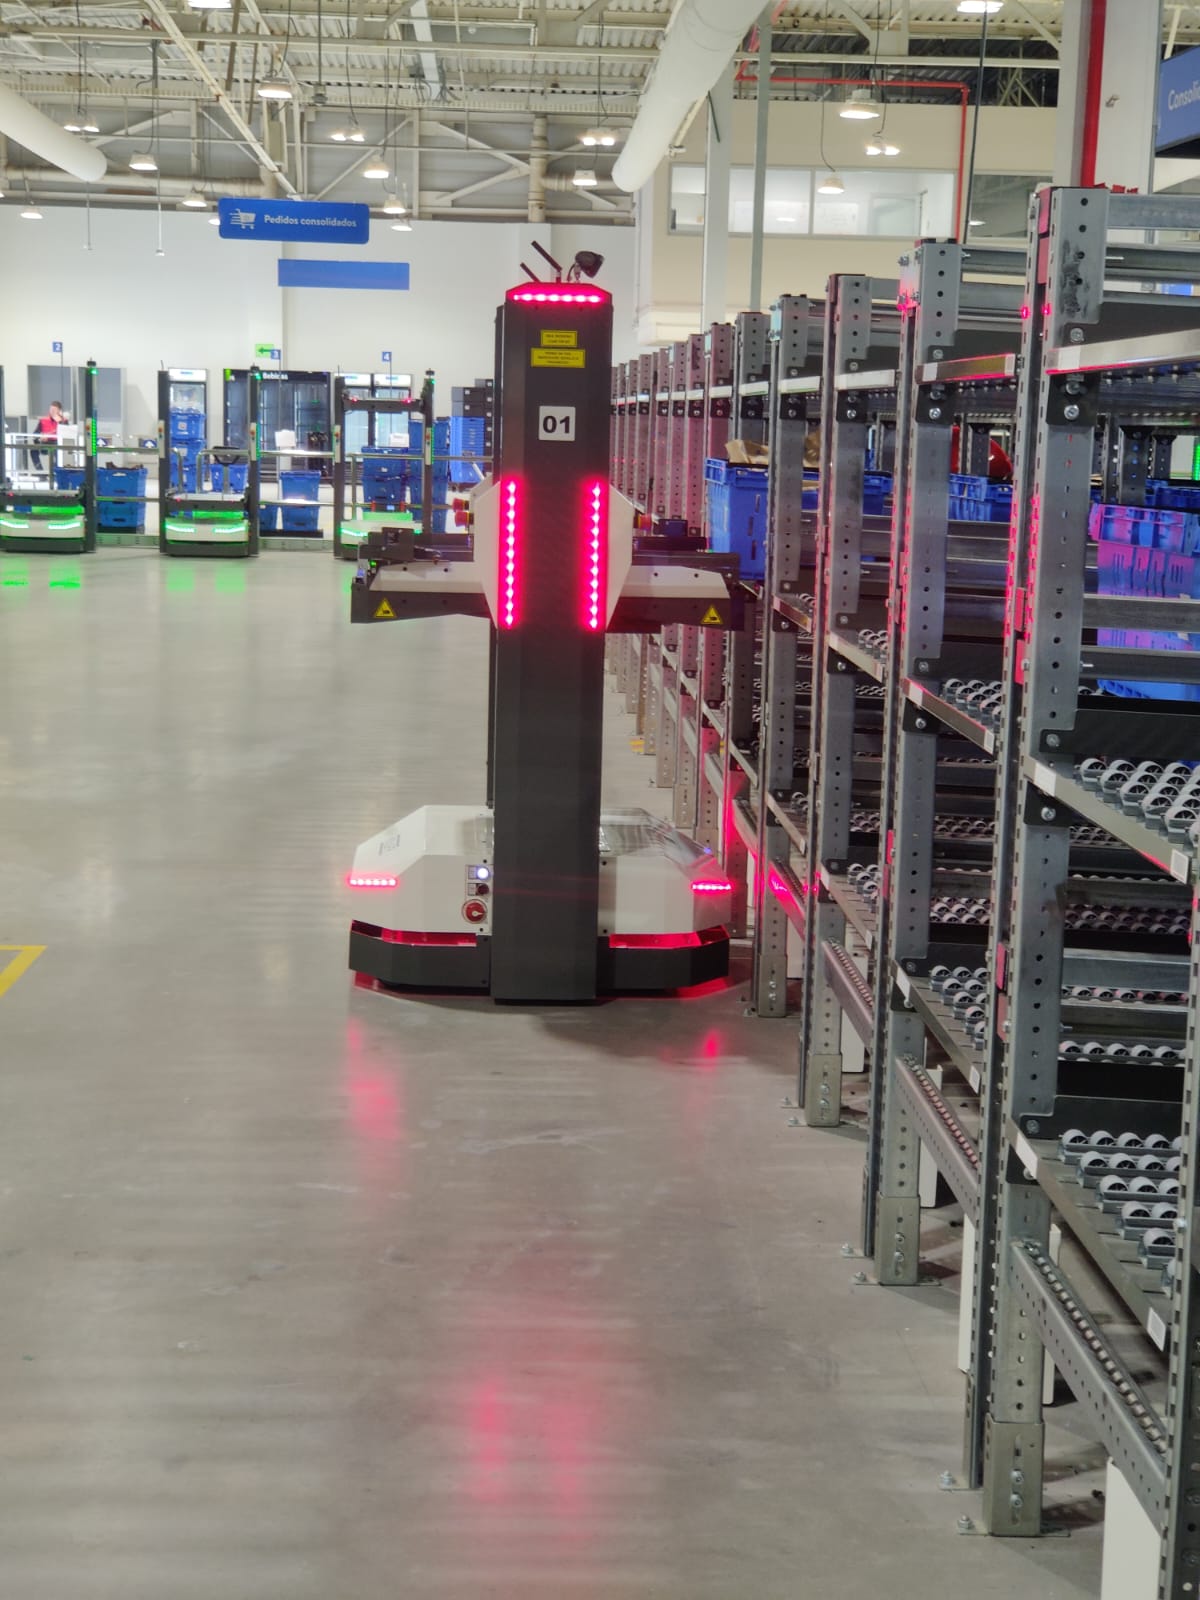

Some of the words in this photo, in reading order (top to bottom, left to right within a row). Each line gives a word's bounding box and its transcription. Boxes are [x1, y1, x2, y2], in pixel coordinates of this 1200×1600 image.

[264, 214, 299, 225] Pedidos
[300, 217, 357, 228] consolidados
[543, 415, 570, 434] 01
